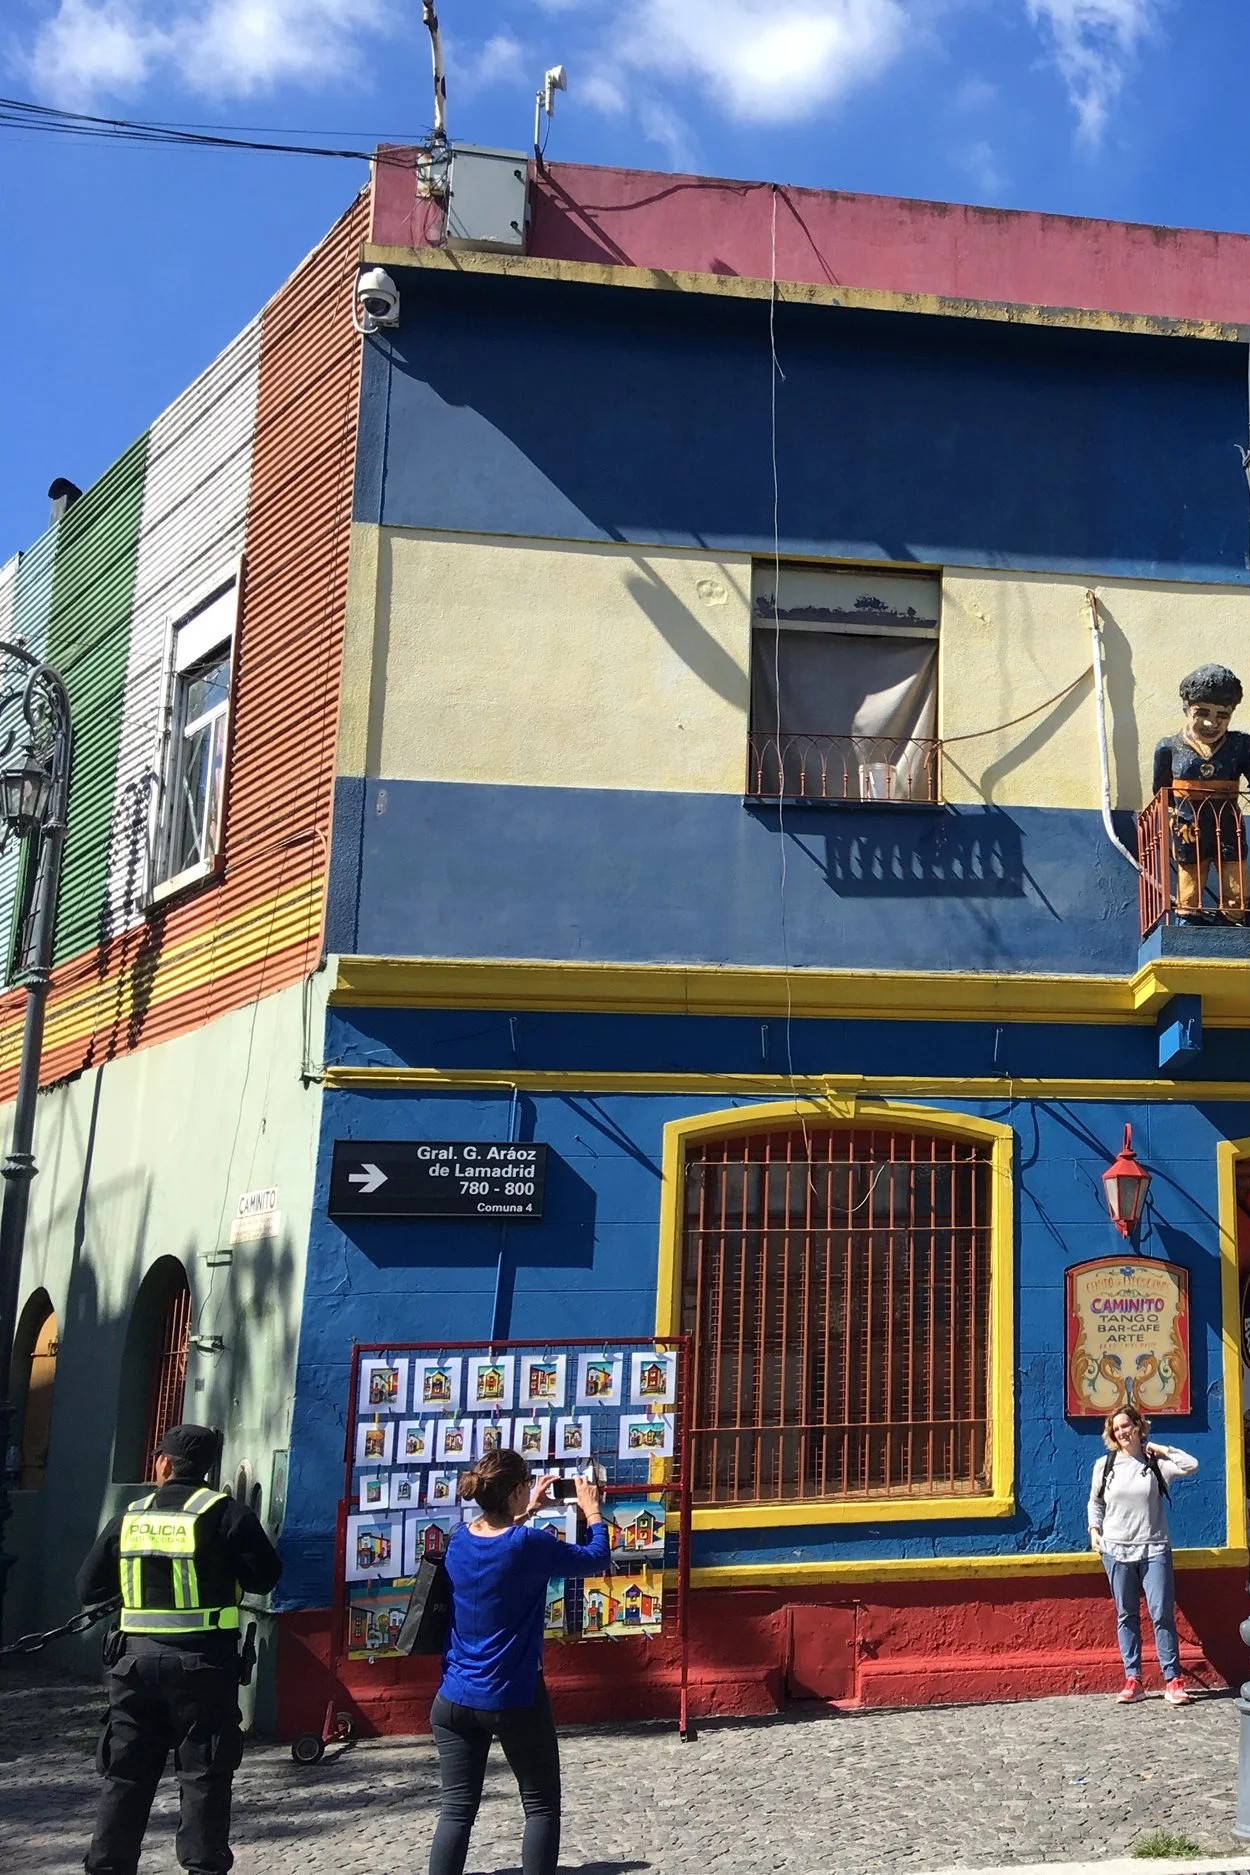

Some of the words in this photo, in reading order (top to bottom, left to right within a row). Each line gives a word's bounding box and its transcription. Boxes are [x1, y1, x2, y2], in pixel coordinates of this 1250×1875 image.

[417, 1146, 458, 1160] Gral.
[463, 1146, 482, 1160] G.
[486, 1146, 536, 1160] Aráoz
[429, 1162, 450, 1177] de
[455, 1164, 535, 1178] Lamadrid
[460, 1182, 489, 1196] 780
[504, 1181, 535, 1196] 800
[239, 1190, 275, 1214] CAMINITO
[477, 1203, 523, 1212] Comuna
[525, 1203, 533, 1213] 4
[1090, 1298, 1165, 1314] CAMINITO
[1099, 1314, 1159, 1323] TANGO
[1106, 1334, 1145, 1343] ARTE
[130, 1524, 187, 1536] POLICIA
